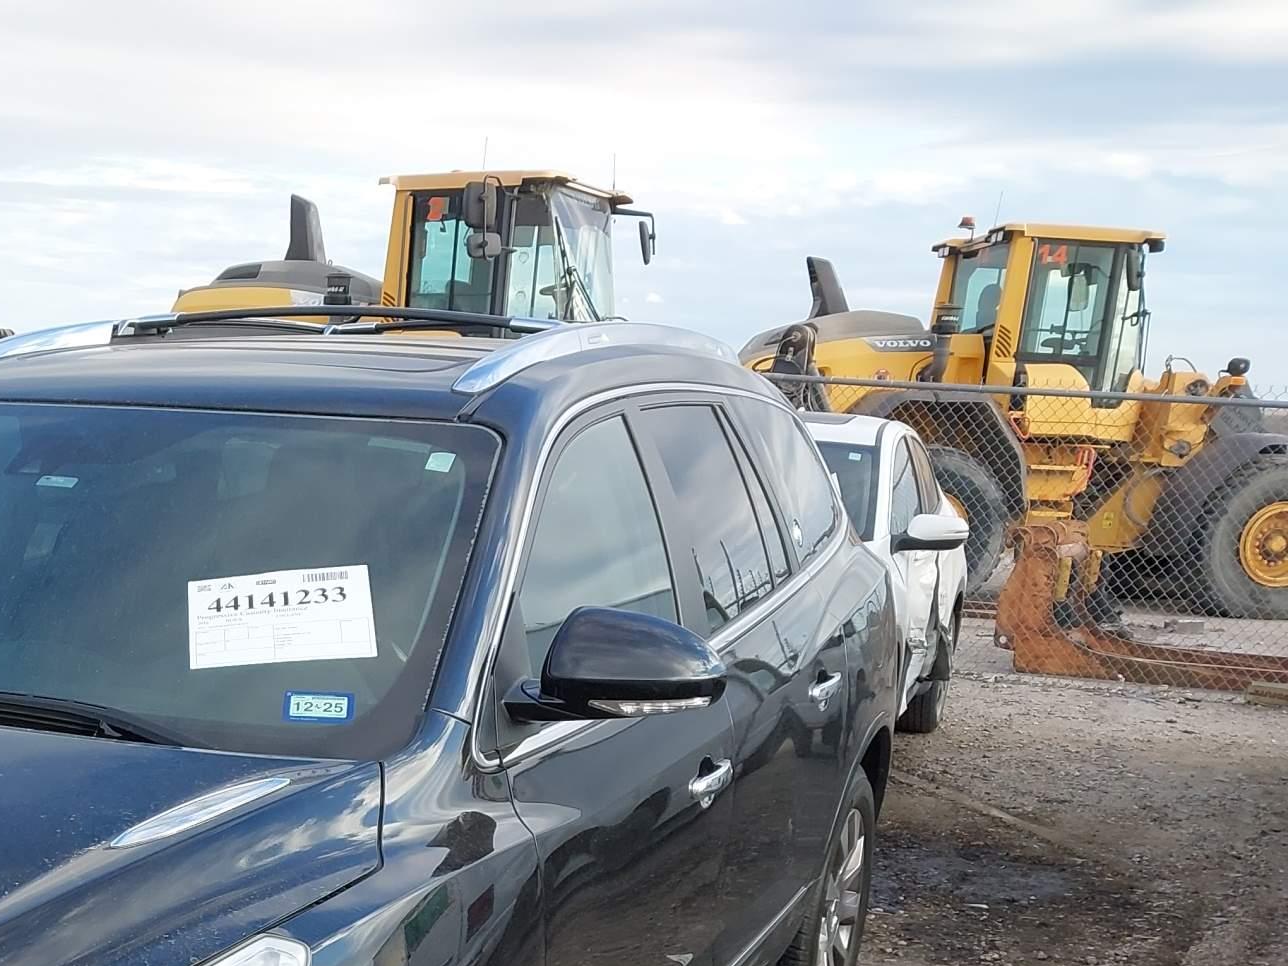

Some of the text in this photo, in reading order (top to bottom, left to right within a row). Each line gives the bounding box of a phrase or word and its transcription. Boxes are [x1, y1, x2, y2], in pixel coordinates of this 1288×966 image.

[1039, 243, 1068, 265] 14
[874, 339, 932, 348] VOLVO
[206, 585, 348, 613] 44141233
